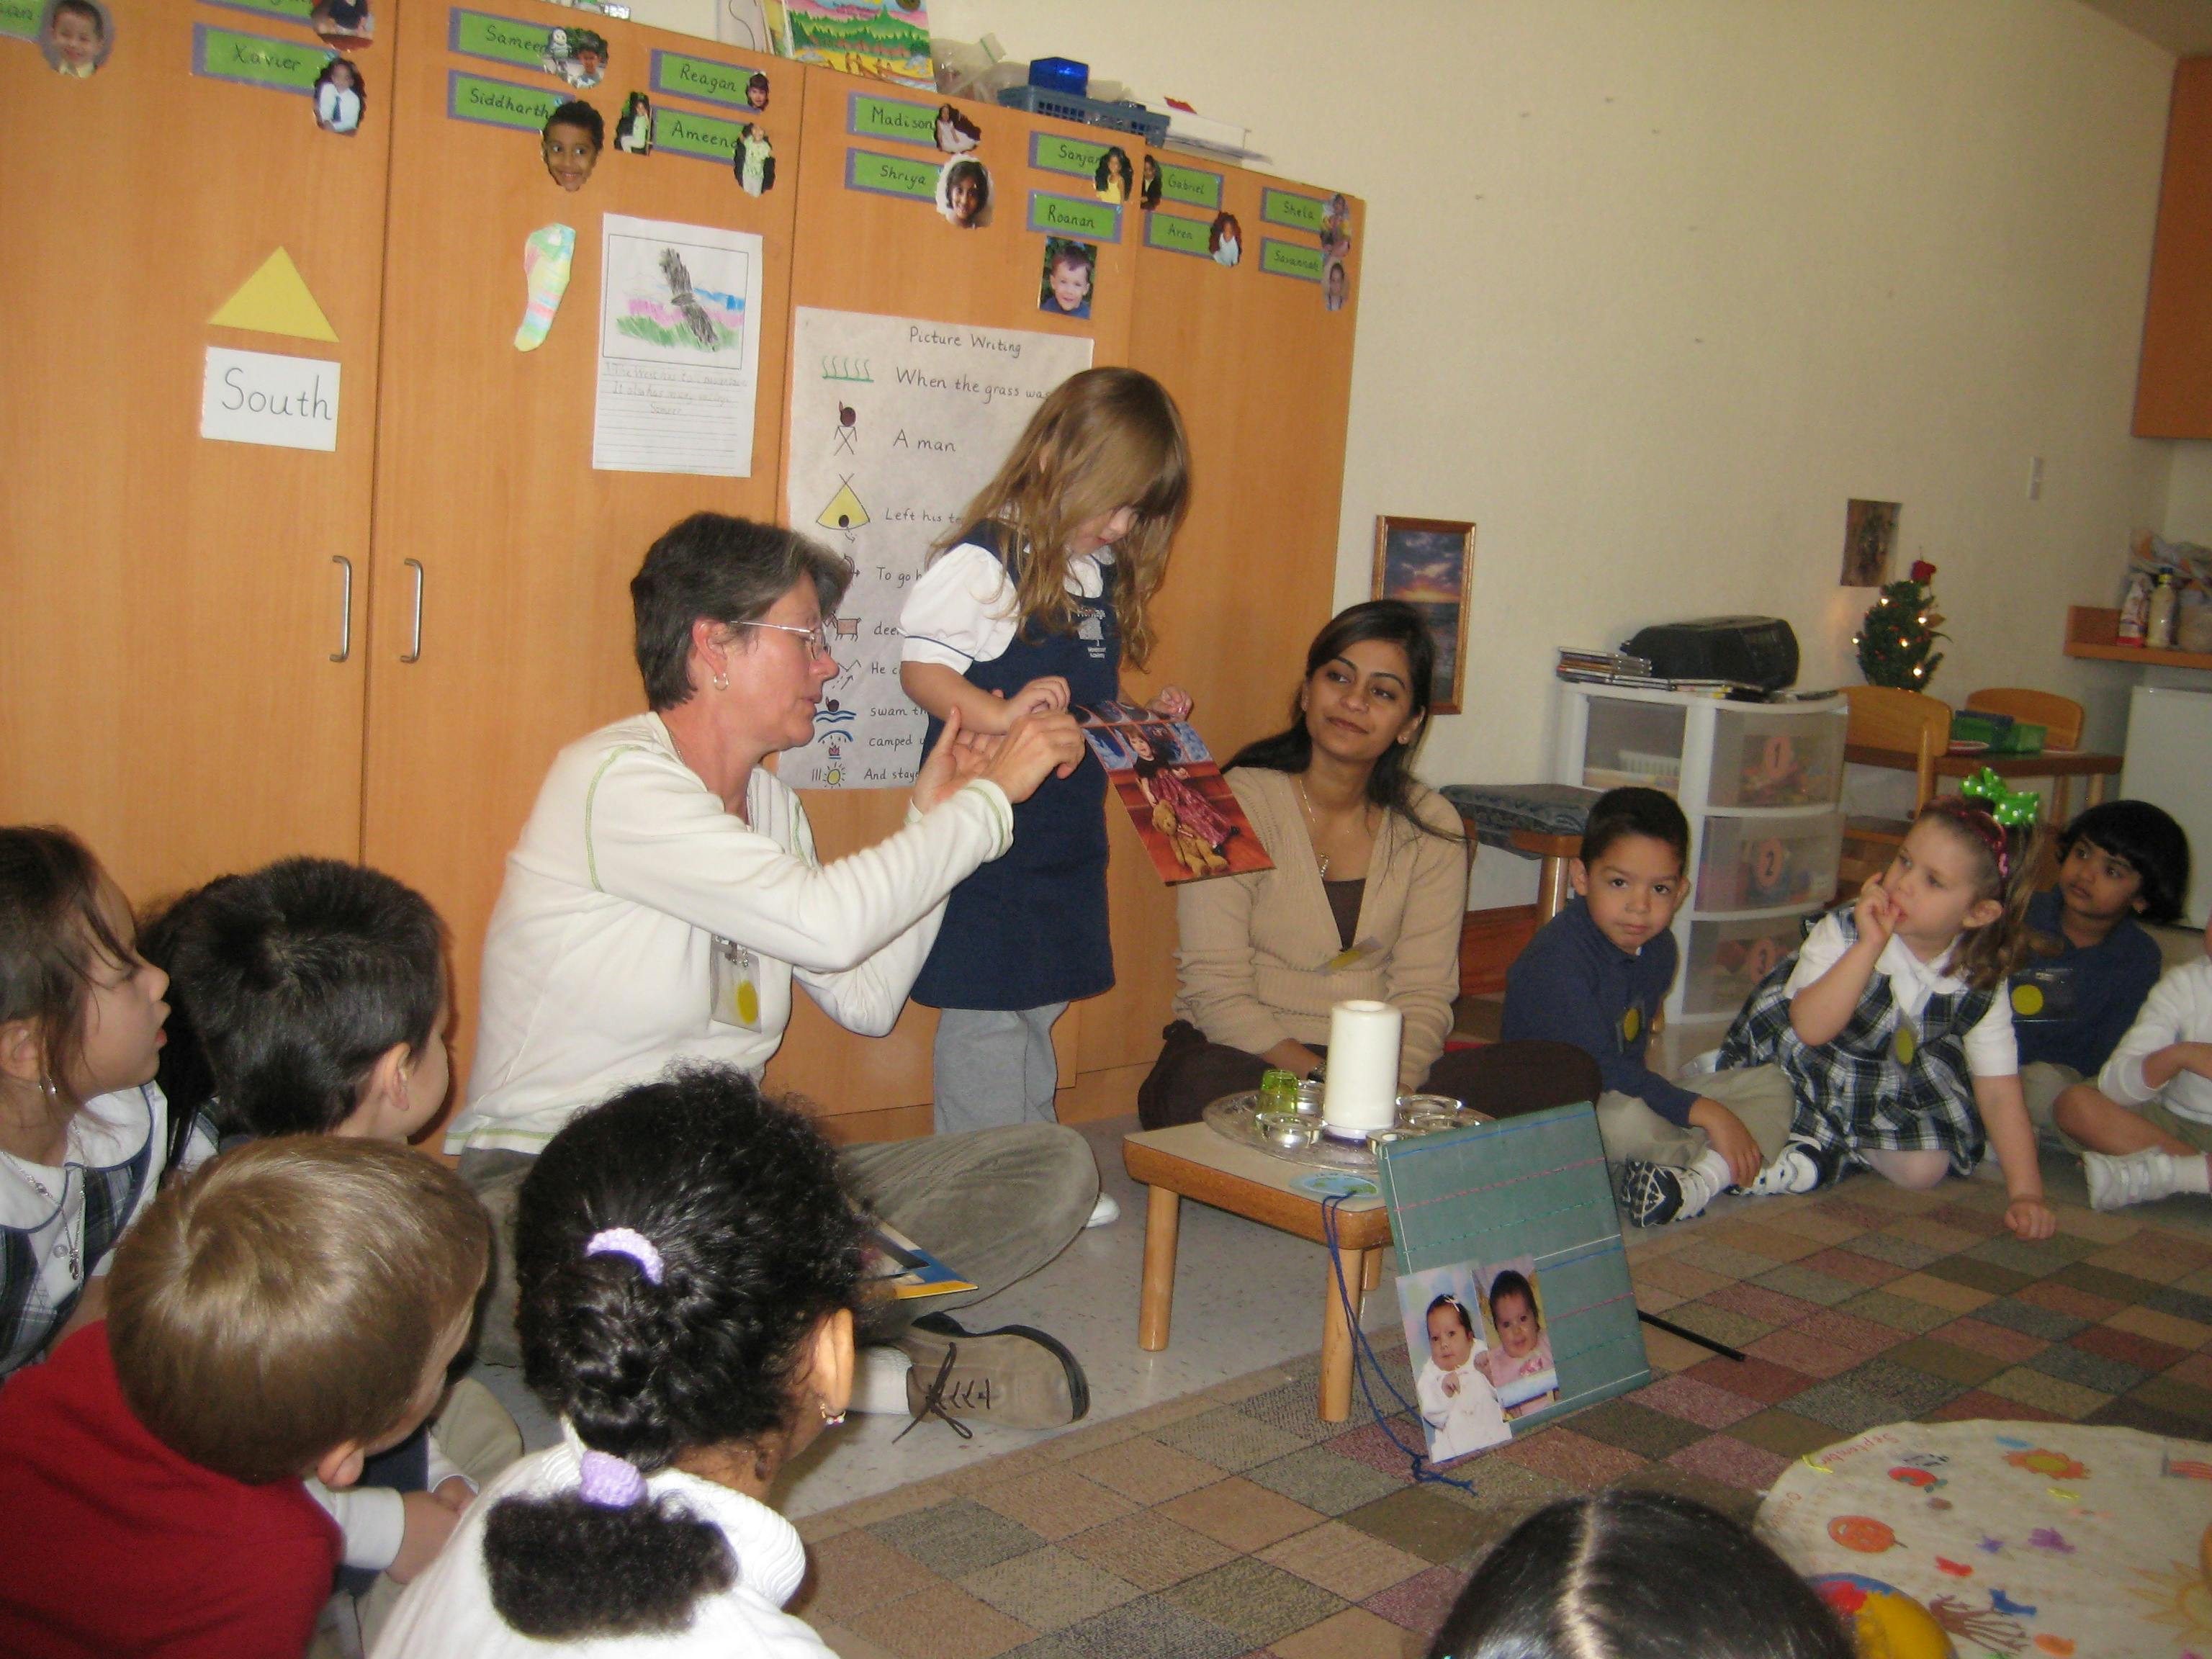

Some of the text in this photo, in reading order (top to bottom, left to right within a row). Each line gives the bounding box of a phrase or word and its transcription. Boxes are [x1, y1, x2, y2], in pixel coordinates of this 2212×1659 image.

[234, 42, 302, 72] Xavier
[680, 63, 736, 94] Reagan
[470, 87, 550, 120] Siddharth
[871, 106, 934, 130] Madison
[880, 164, 926, 190] Shriya
[1169, 174, 1205, 194] Gabriel
[1048, 204, 1094, 229] Roanan
[909, 326, 1022, 359] Picture Writing
[221, 367, 333, 421] South
[895, 367, 948, 390] When
[955, 374, 979, 393] the
[984, 385, 1020, 404] grass
[893, 428, 956, 453] A man
[885, 507, 915, 522] Left
[922, 508, 943, 523] his
[877, 567, 891, 582] To
[898, 572, 912, 589] go
[871, 661, 889, 675] He
[870, 706, 907, 717] swam
[869, 735, 914, 754] camped
[863, 768, 886, 781] And
[1764, 850, 1776, 876] 2
